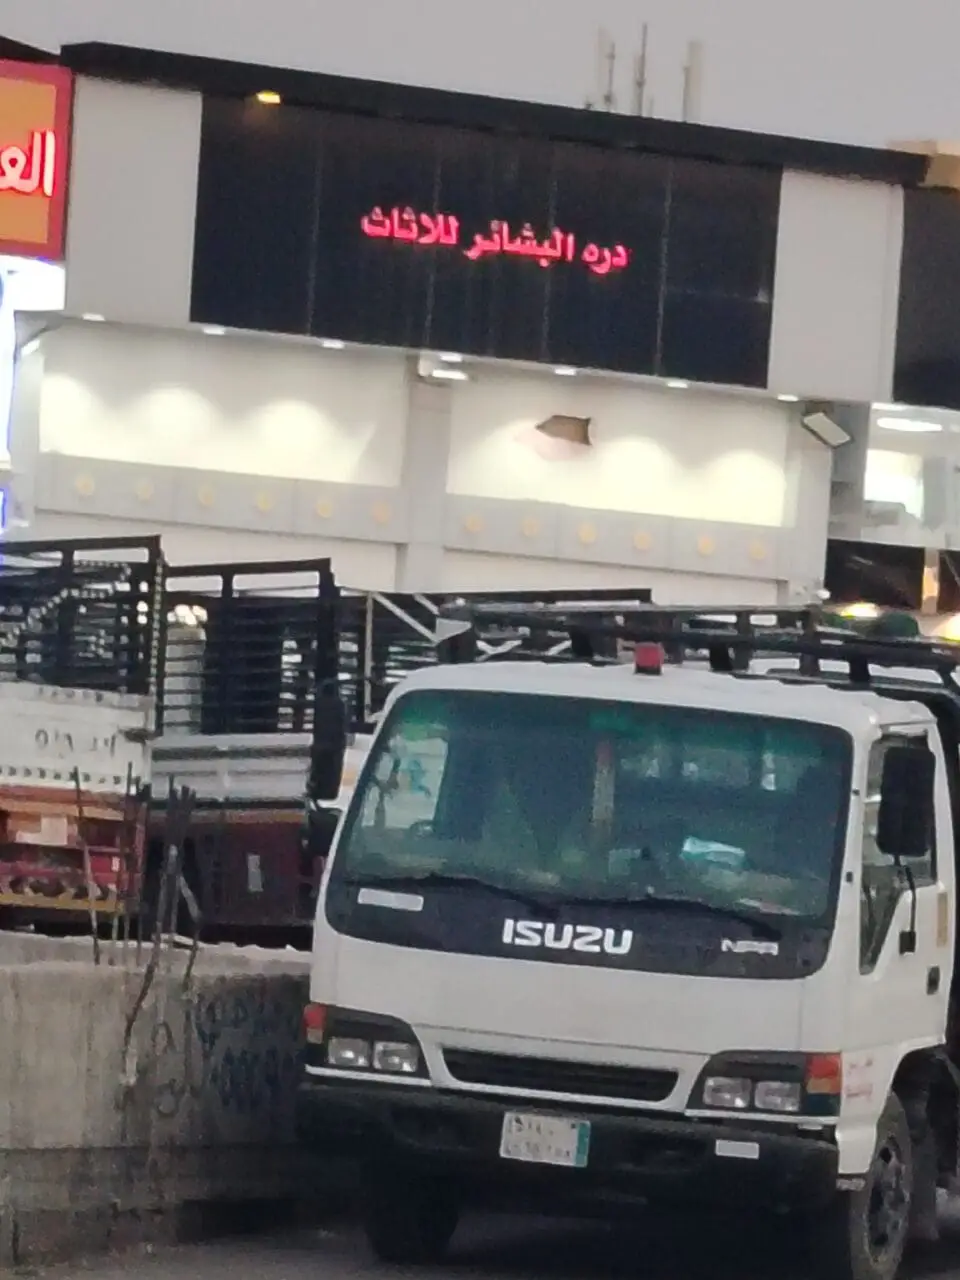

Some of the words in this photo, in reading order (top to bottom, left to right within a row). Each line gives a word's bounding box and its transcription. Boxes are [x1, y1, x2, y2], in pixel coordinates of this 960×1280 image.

[463, 219, 575, 267] البشائر
[581, 241, 630, 275] دره
[502, 917, 634, 956] ISUZU
